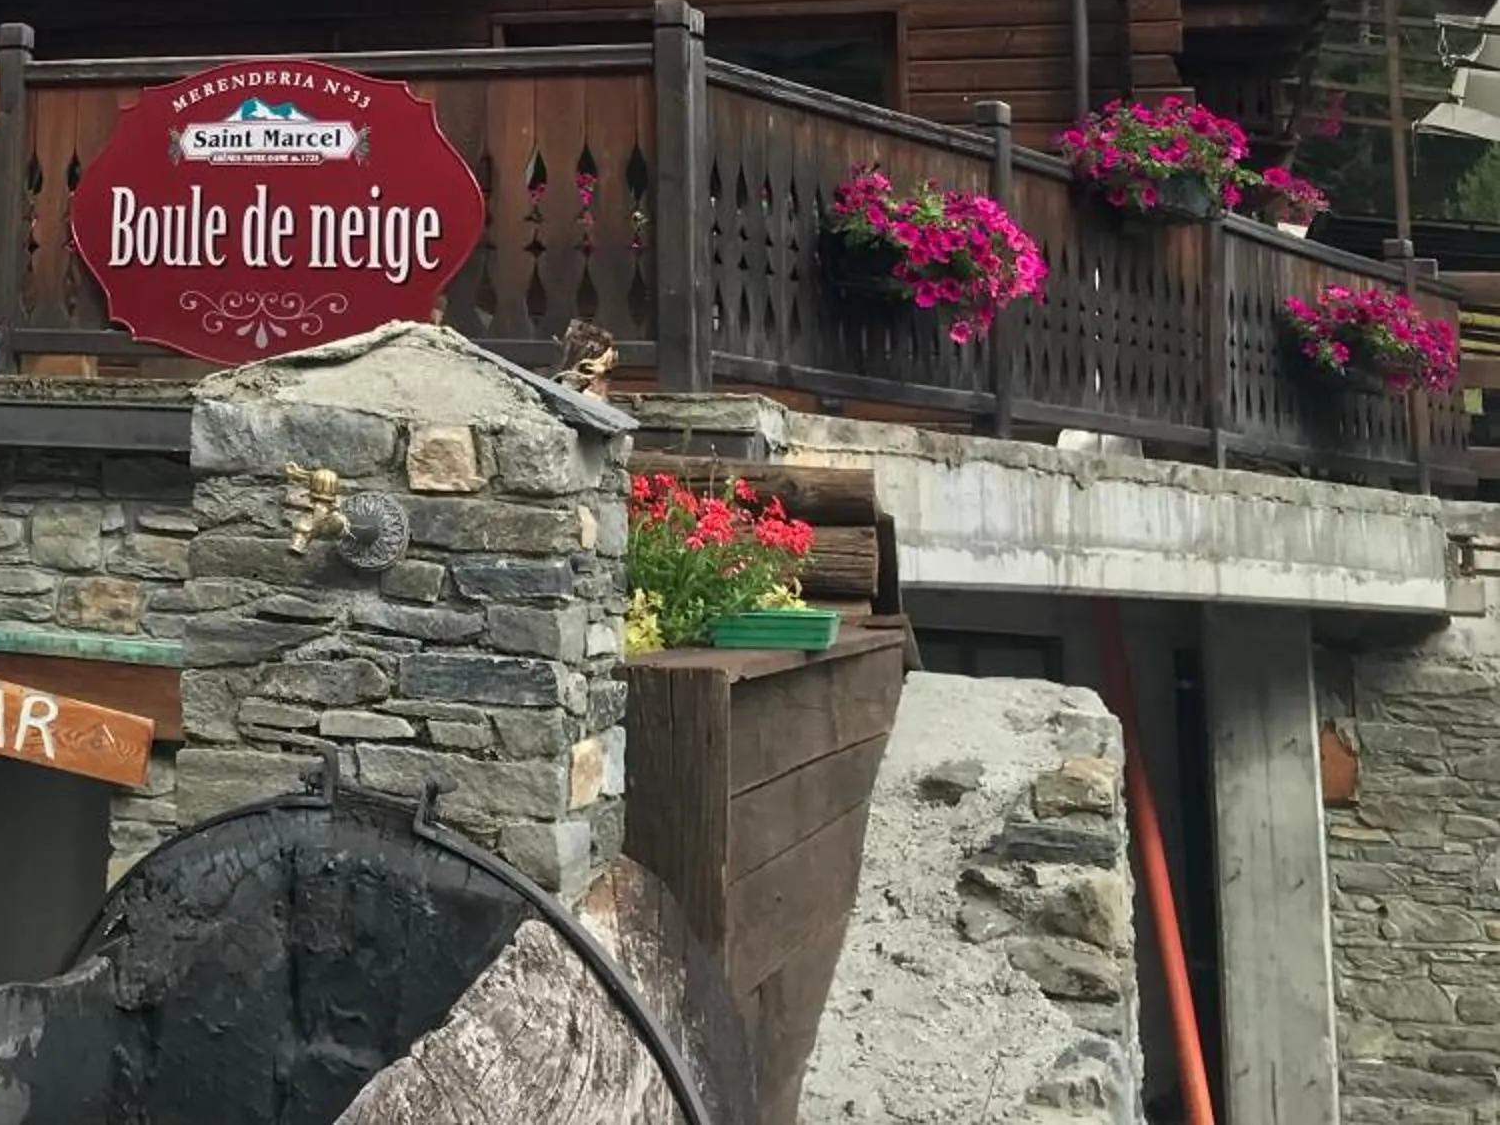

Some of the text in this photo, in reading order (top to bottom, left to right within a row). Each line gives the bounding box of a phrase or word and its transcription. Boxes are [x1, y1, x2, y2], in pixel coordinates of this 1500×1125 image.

[171, 70, 315, 114] MERENDERIA
[192, 128, 342, 149] Saint Marcel
[108, 184, 442, 284] Boule de neige
